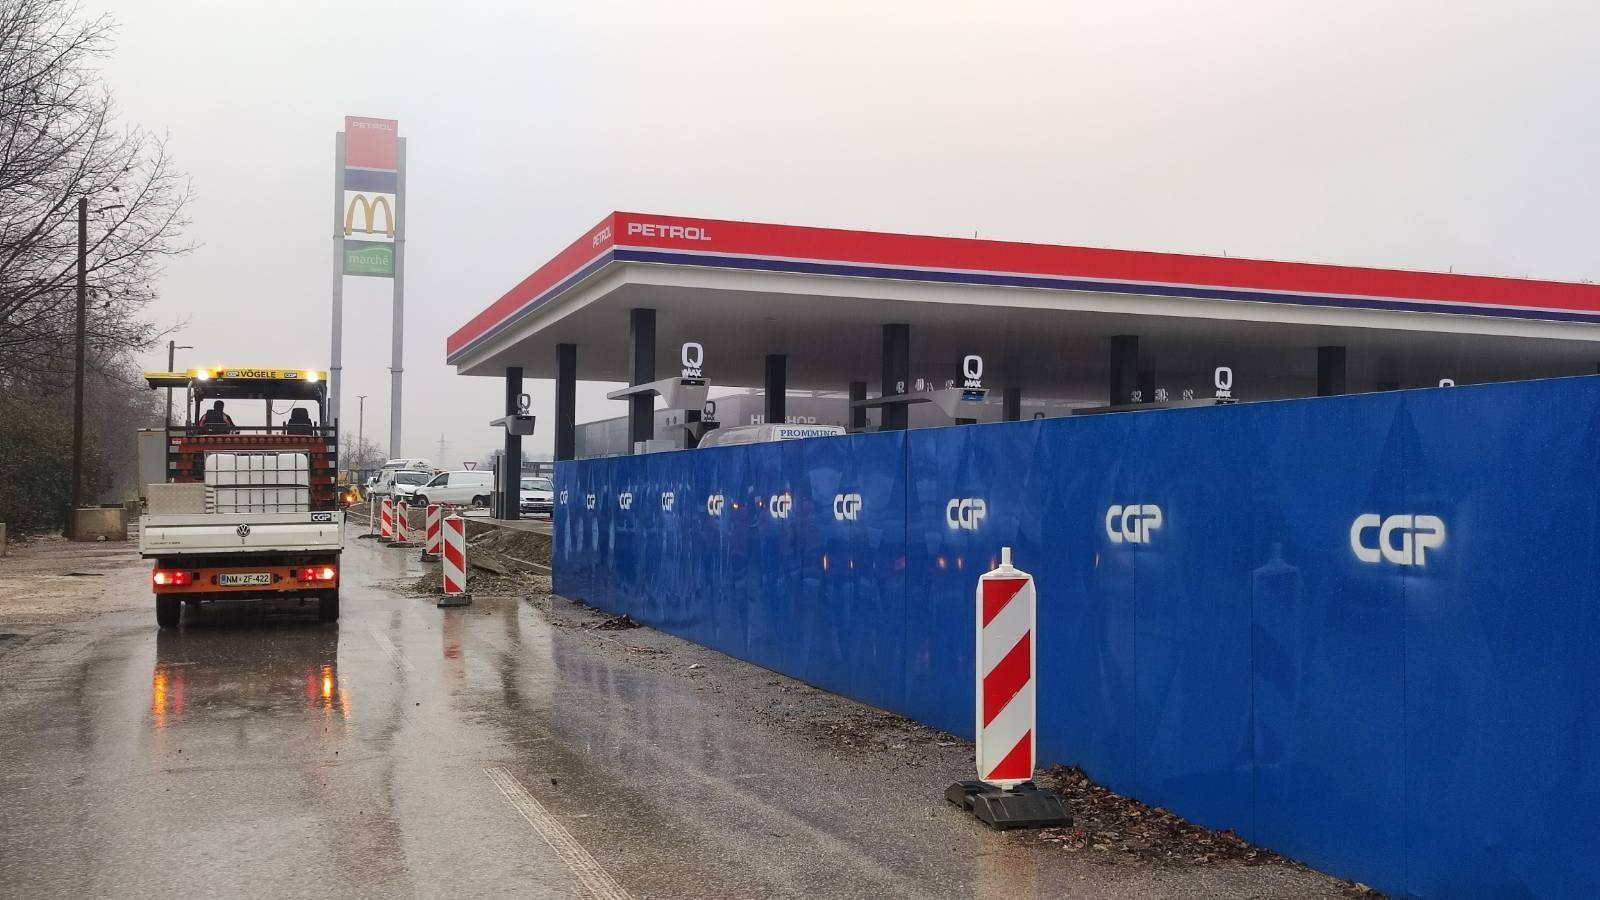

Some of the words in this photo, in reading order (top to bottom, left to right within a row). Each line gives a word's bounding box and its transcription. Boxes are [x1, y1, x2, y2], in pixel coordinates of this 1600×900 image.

[352, 121, 393, 131] PETROL
[592, 226, 611, 249] PETROL
[627, 222, 712, 241] PETROL
[349, 254, 389, 266] marché
[681, 342, 704, 369] Q
[241, 370, 277, 379] VÖGELE
[963, 355, 983, 379] Q
[1214, 366, 1233, 390] Q
[516, 393, 531, 409] Q
[780, 429, 838, 438] PROMMING
[619, 492, 633, 510] CGP
[661, 492, 675, 511] CGP
[707, 494, 725, 516] CGP
[769, 493, 792, 519] CGP
[833, 493, 862, 521] CGP
[312, 513, 331, 521] CGP
[946, 498, 987, 530] CGP
[1105, 503, 1163, 544] CGP
[1350, 513, 1446, 566] CGP
[226, 575, 238, 583] NM
[243, 574, 269, 583] ZF-422
